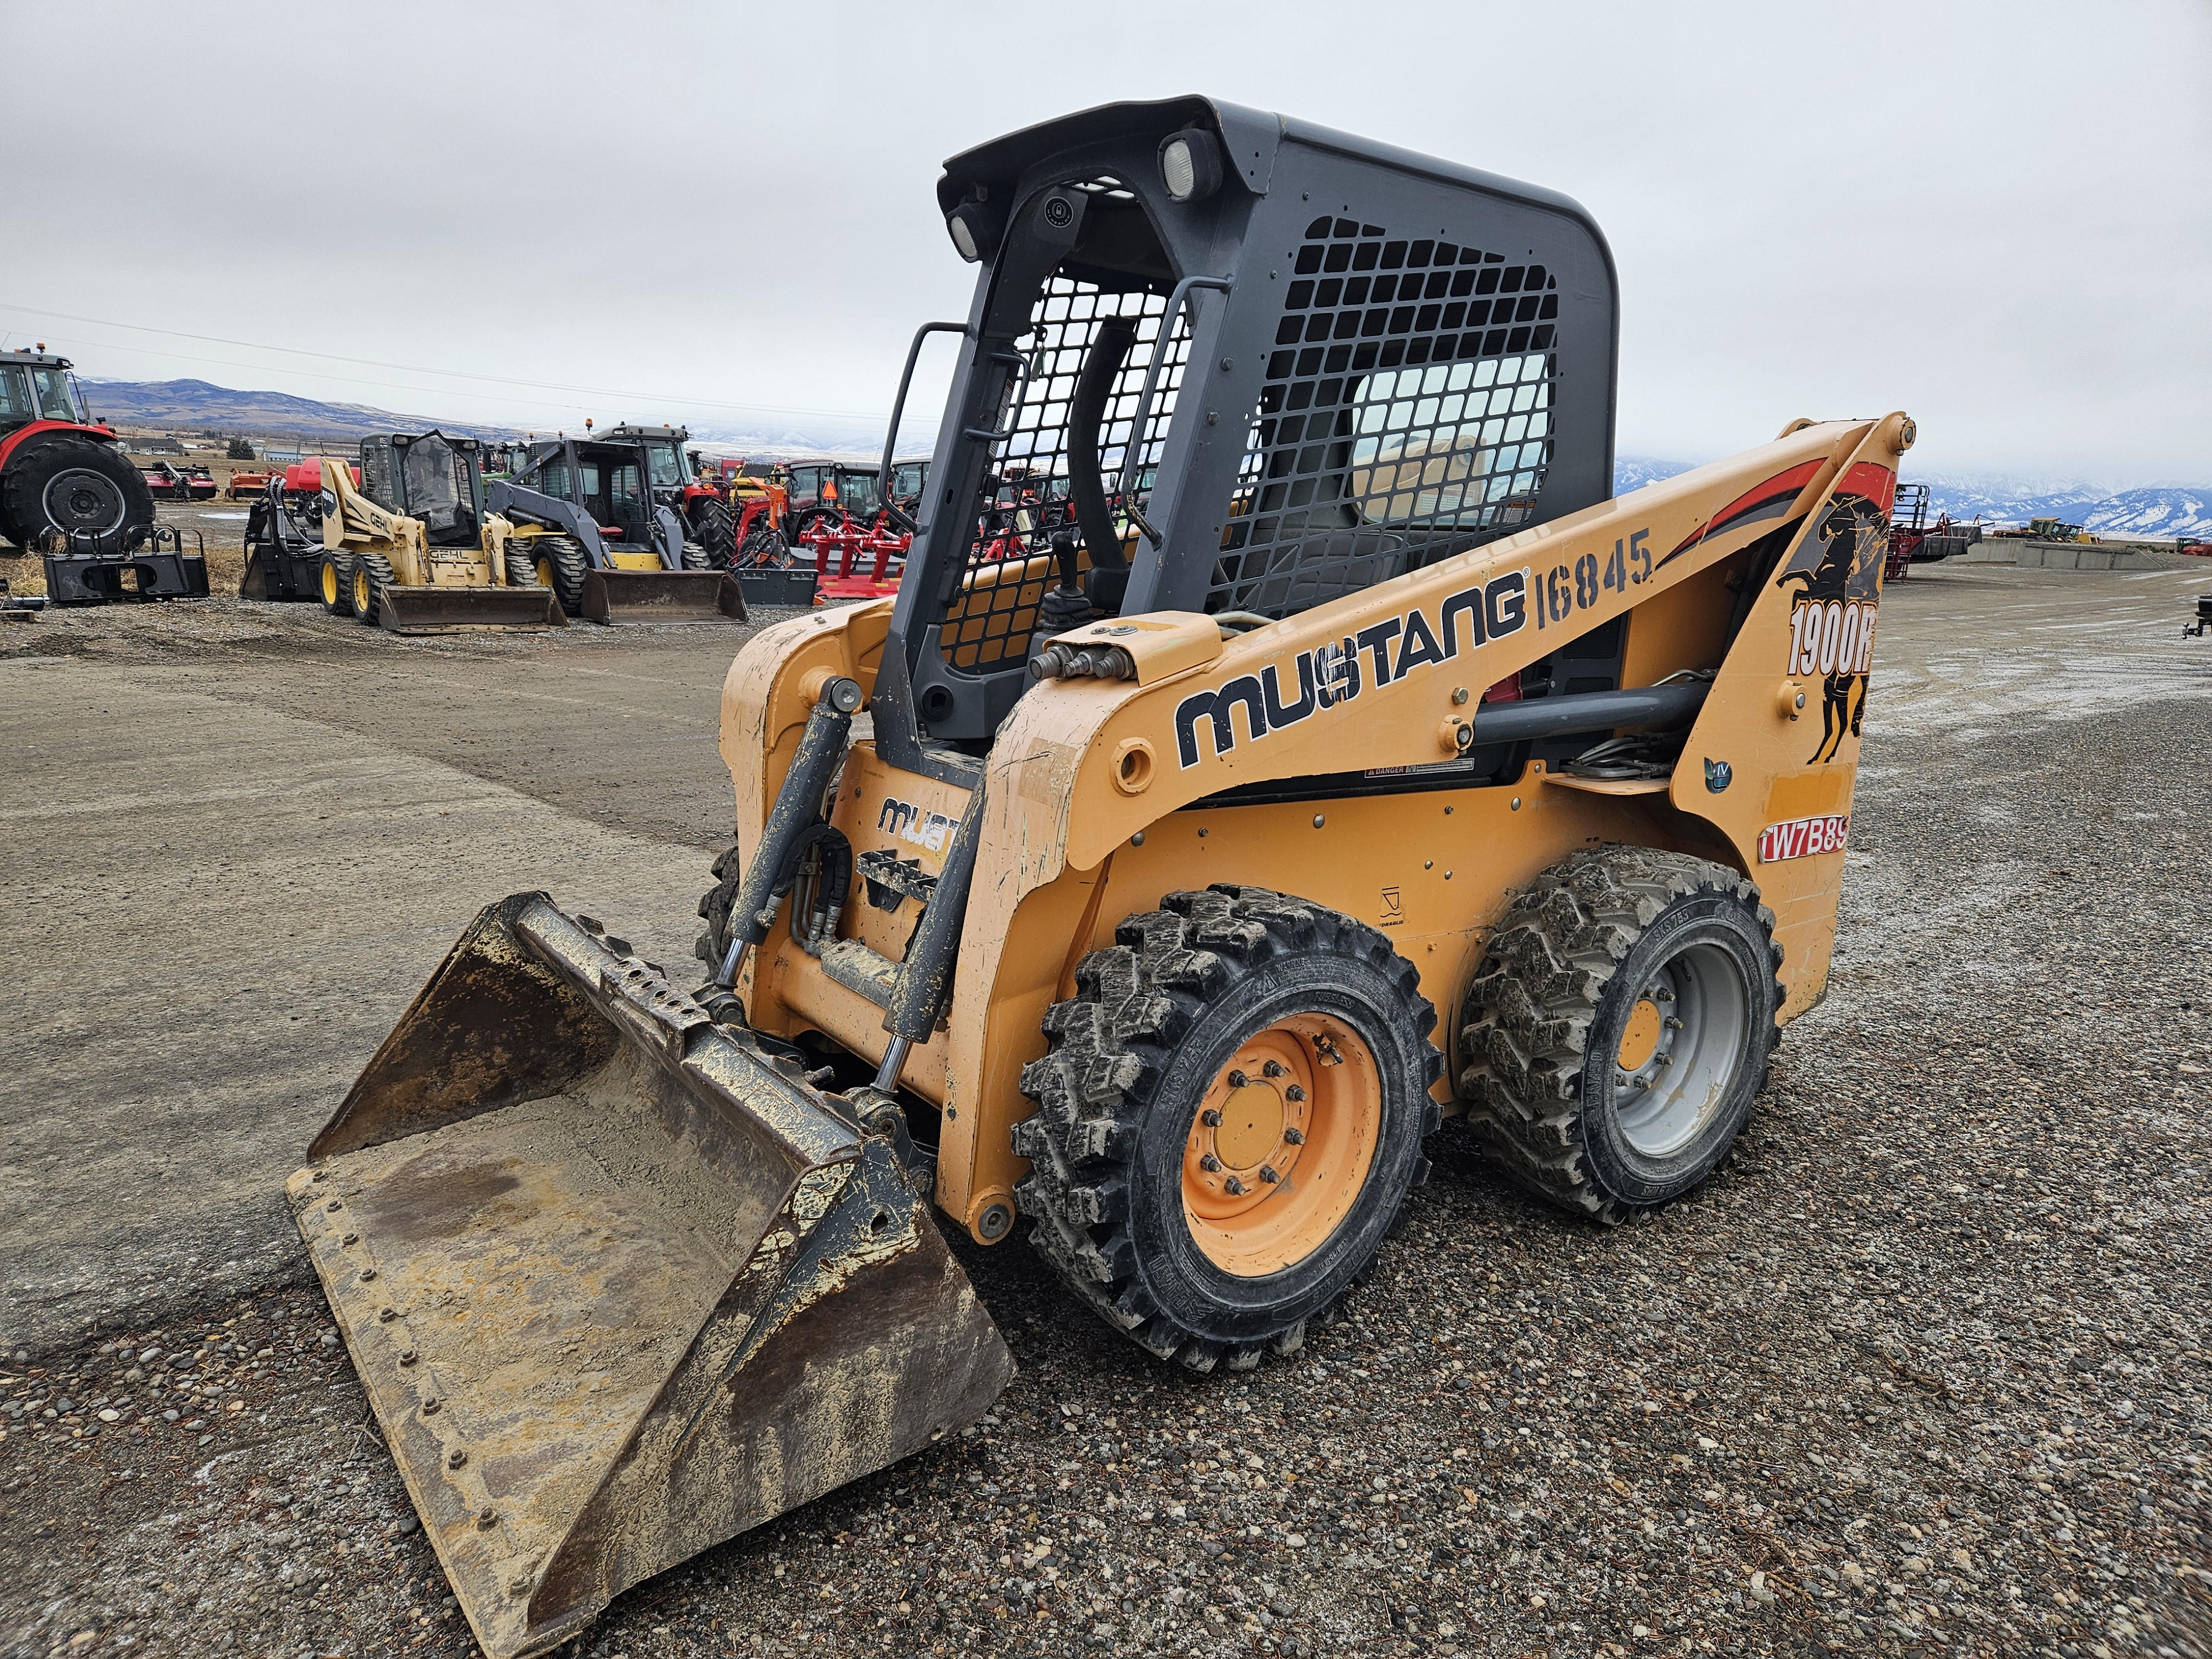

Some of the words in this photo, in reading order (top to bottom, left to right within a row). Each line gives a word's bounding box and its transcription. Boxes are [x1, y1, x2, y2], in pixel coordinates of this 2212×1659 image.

[370, 512, 390, 535] GEHL
[429, 550, 469, 560] GEHL
[1535, 527, 1652, 630] 16845
[1375, 766, 1404, 775] DANGER
[1147, 1254, 1190, 1310] CAMSO
